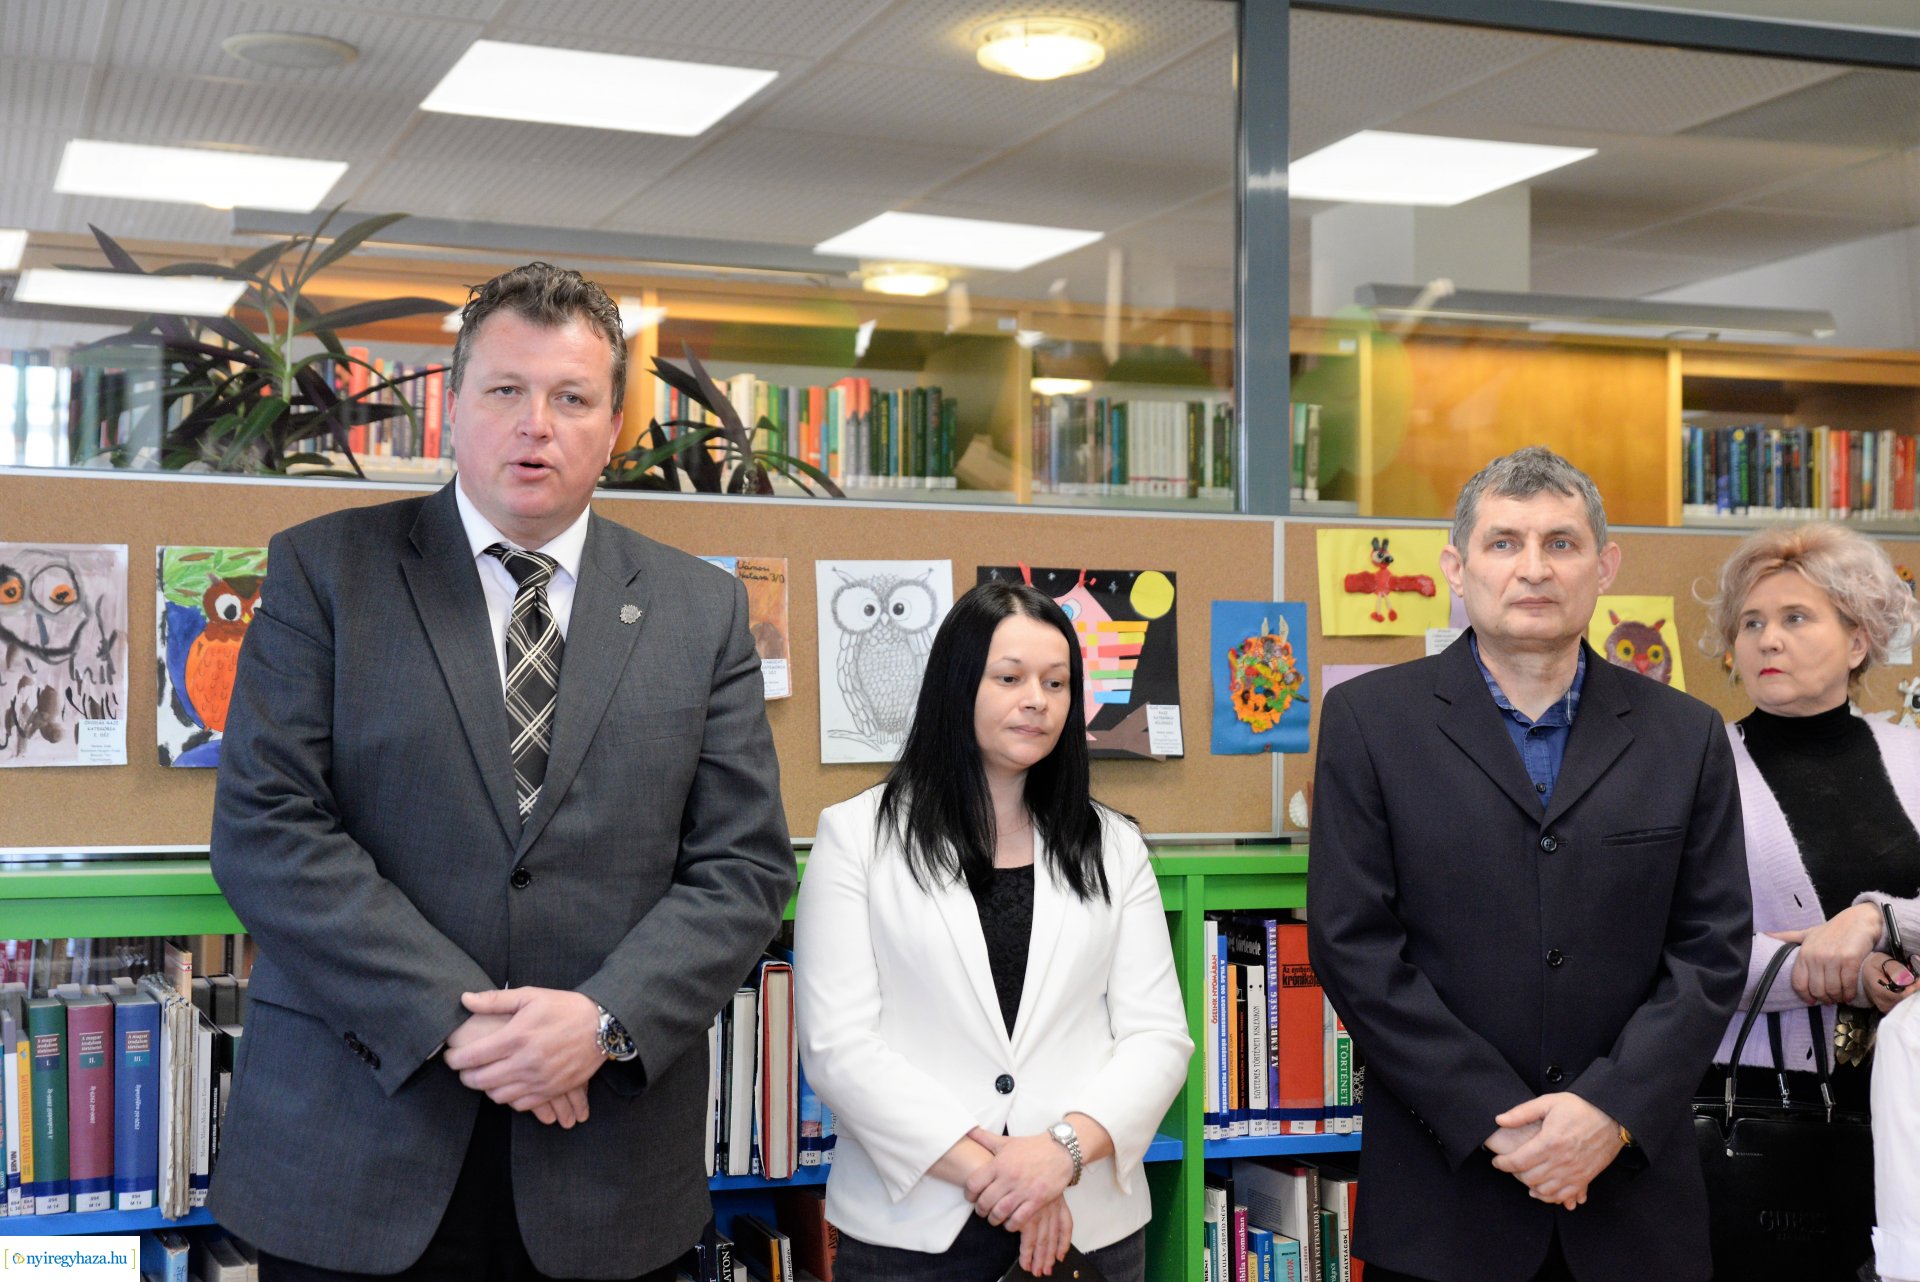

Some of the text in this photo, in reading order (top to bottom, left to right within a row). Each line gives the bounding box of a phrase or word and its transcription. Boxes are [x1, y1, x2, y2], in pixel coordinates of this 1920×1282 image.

[1210, 955, 1218, 997] NYOMÁBAN
[1268, 927, 1279, 1068] AZ EMBERISÉG TÖRTÉNETE
[1252, 1037, 1260, 1067] TÖRTÉNETI
[1238, 1216, 1247, 1259] nyomában
[1313, 1210, 1321, 1257] TÖRTÉNELEM
